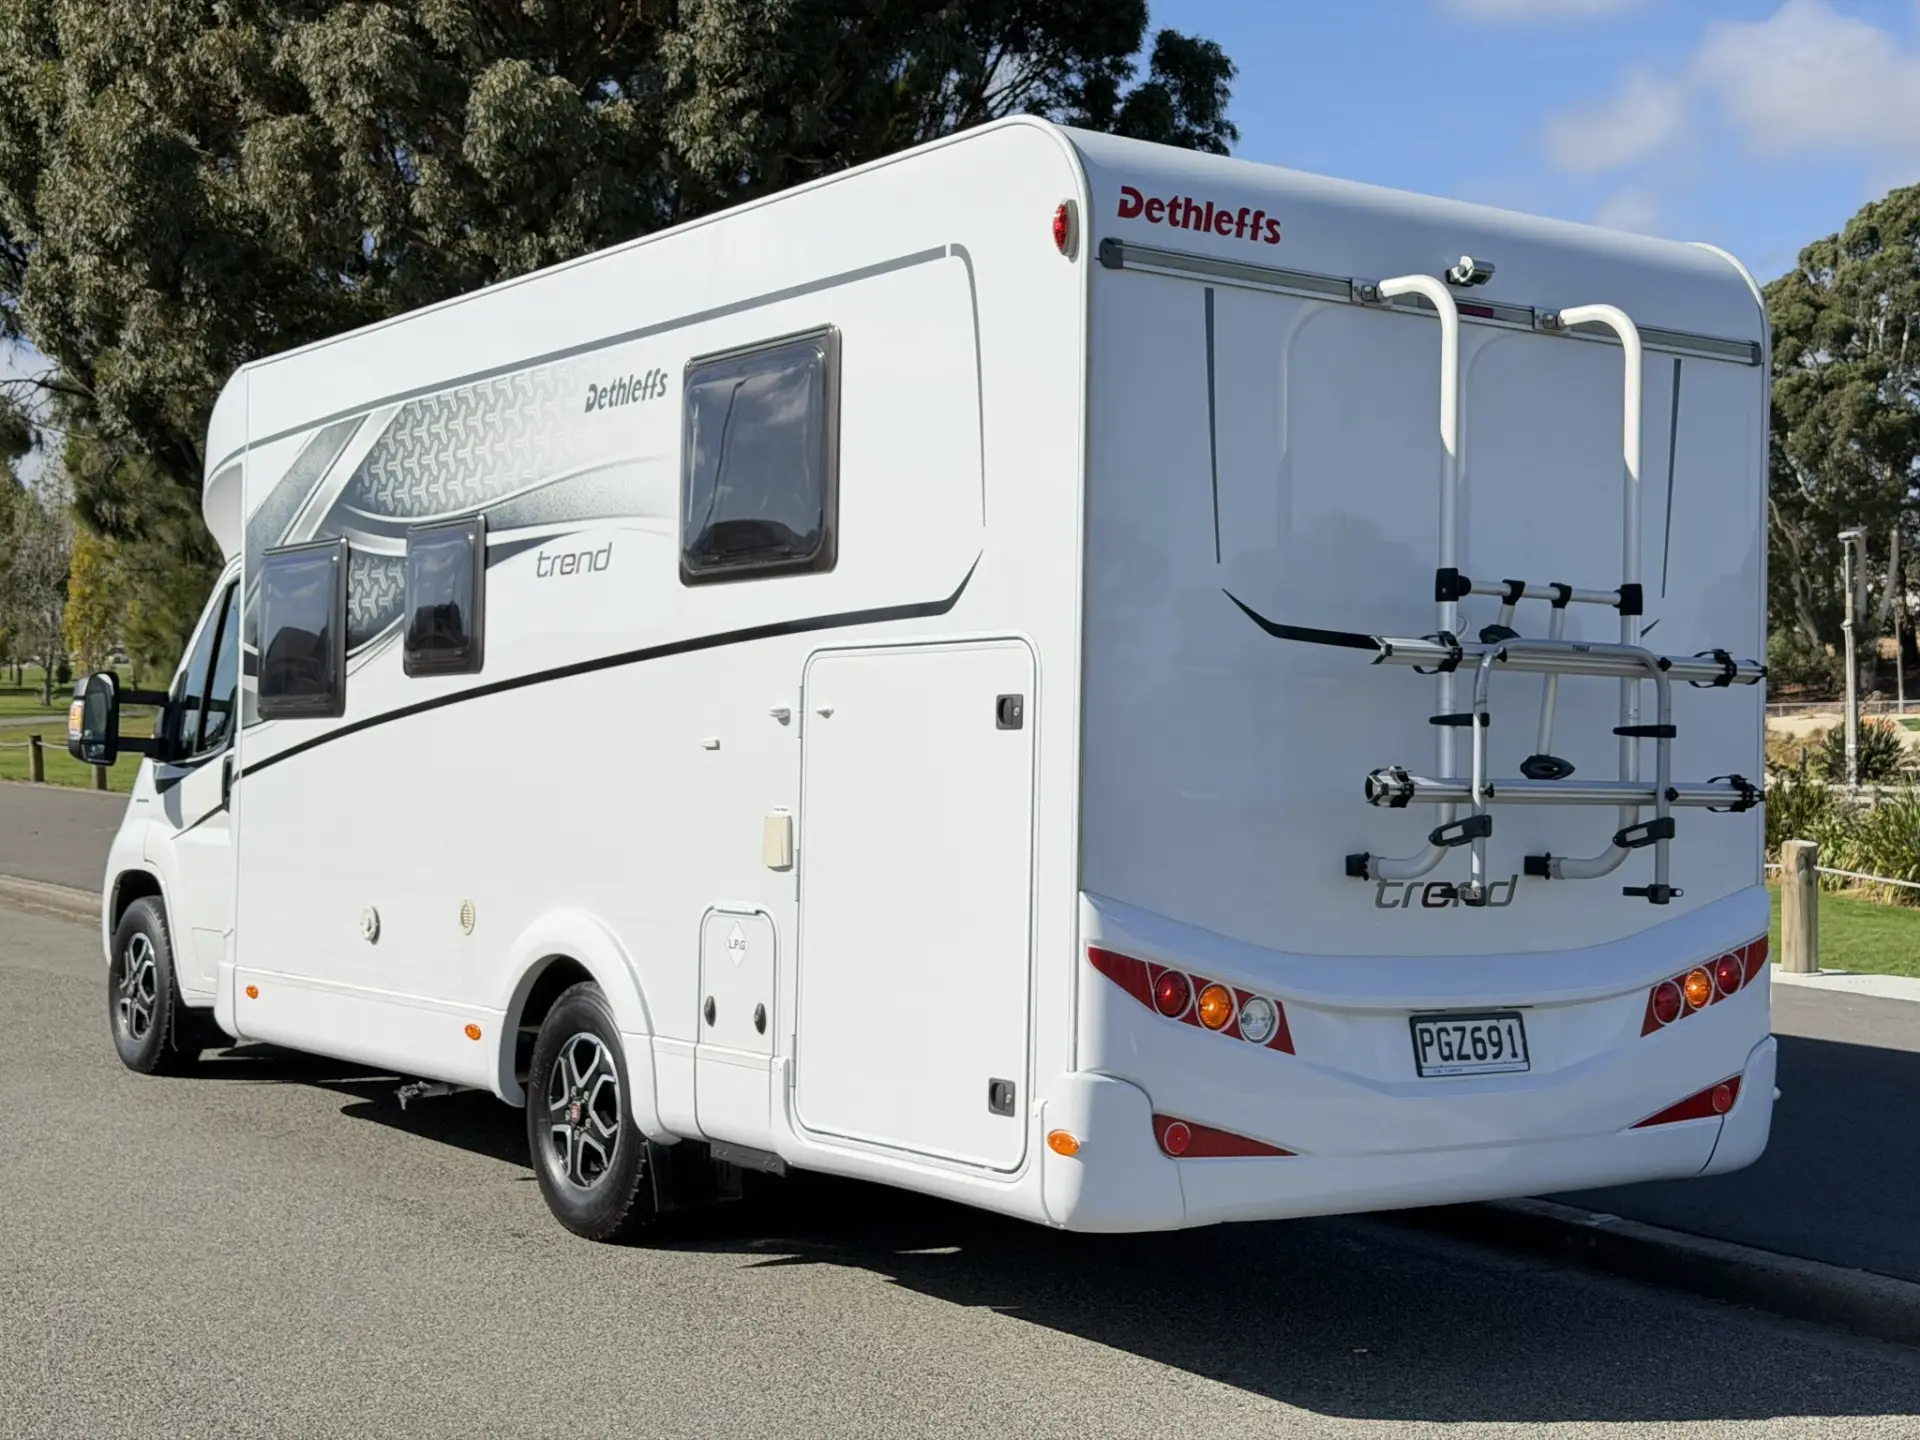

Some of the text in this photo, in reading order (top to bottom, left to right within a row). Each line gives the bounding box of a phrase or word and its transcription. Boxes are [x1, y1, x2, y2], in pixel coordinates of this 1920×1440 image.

[1117, 185, 1281, 245] Dethleffs
[584, 368, 668, 413] Dethleffs
[536, 542, 613, 578] trend
[1418, 1024, 1518, 1063] PGZ691
